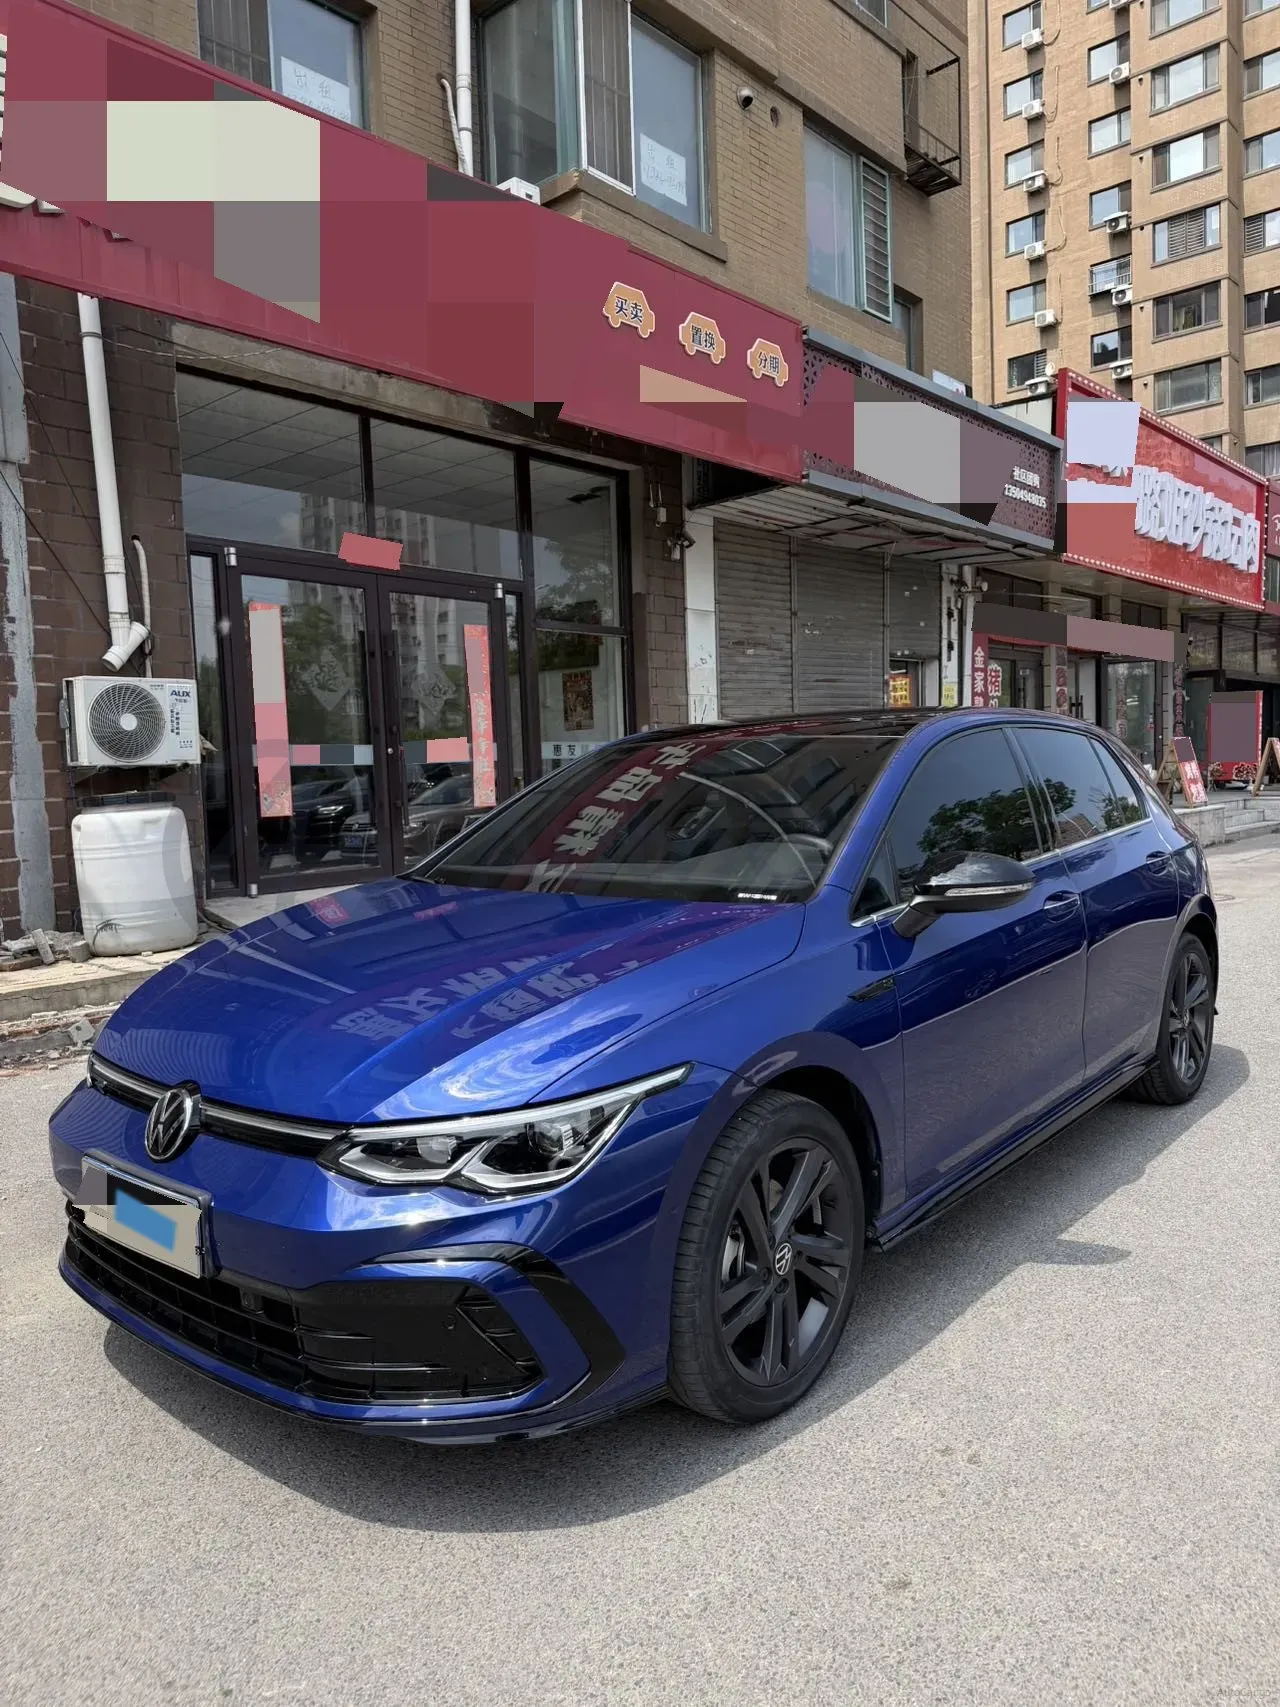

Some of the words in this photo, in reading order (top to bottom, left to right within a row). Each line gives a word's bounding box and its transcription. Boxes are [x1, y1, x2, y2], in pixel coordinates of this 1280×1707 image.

[615, 295, 643, 323] 买卖
[691, 324, 716, 351] 置换
[758, 351, 780, 374] 分期
